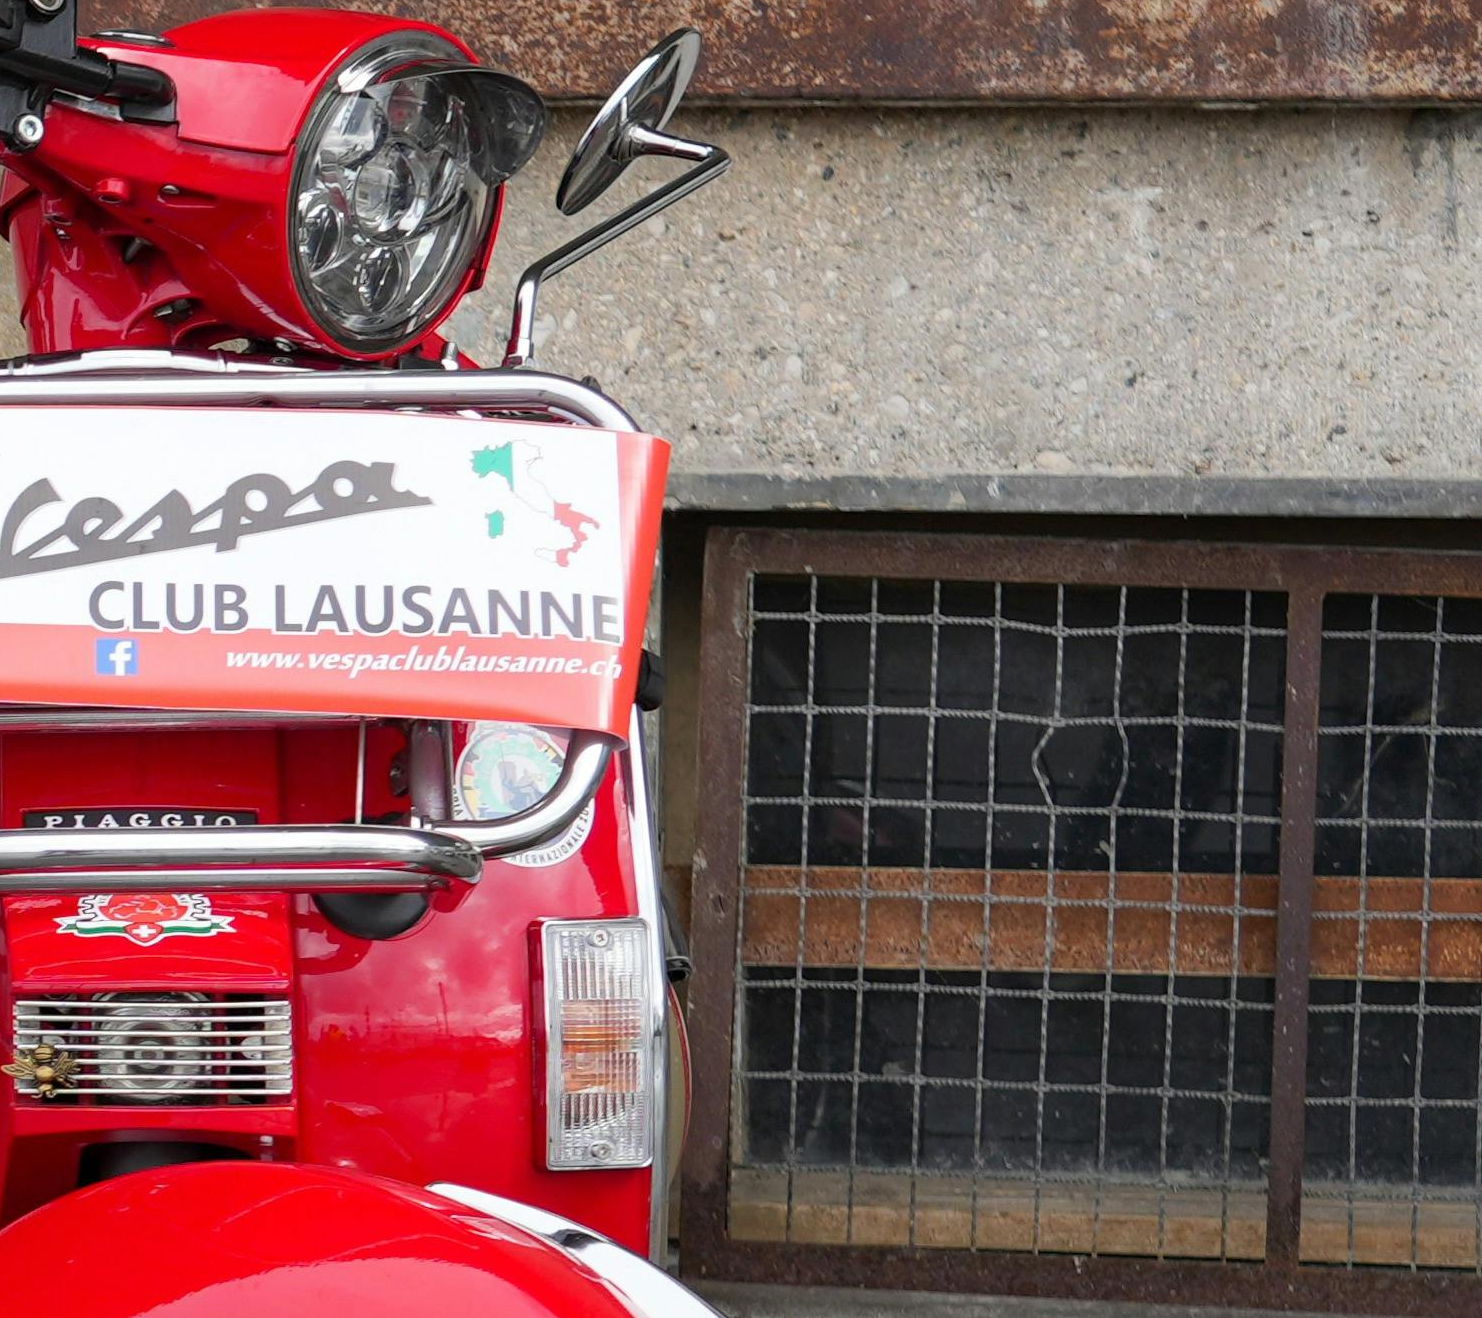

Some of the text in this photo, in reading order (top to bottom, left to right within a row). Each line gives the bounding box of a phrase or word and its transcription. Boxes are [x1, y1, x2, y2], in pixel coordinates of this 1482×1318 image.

[88, 580, 622, 644] CLUB LAUSANNE
[226, 647, 622, 680] www.vespaclublausanne.ch
[43, 813, 237, 828] PIAGGIO
[509, 816, 586, 864] NTERNAZIONALE
